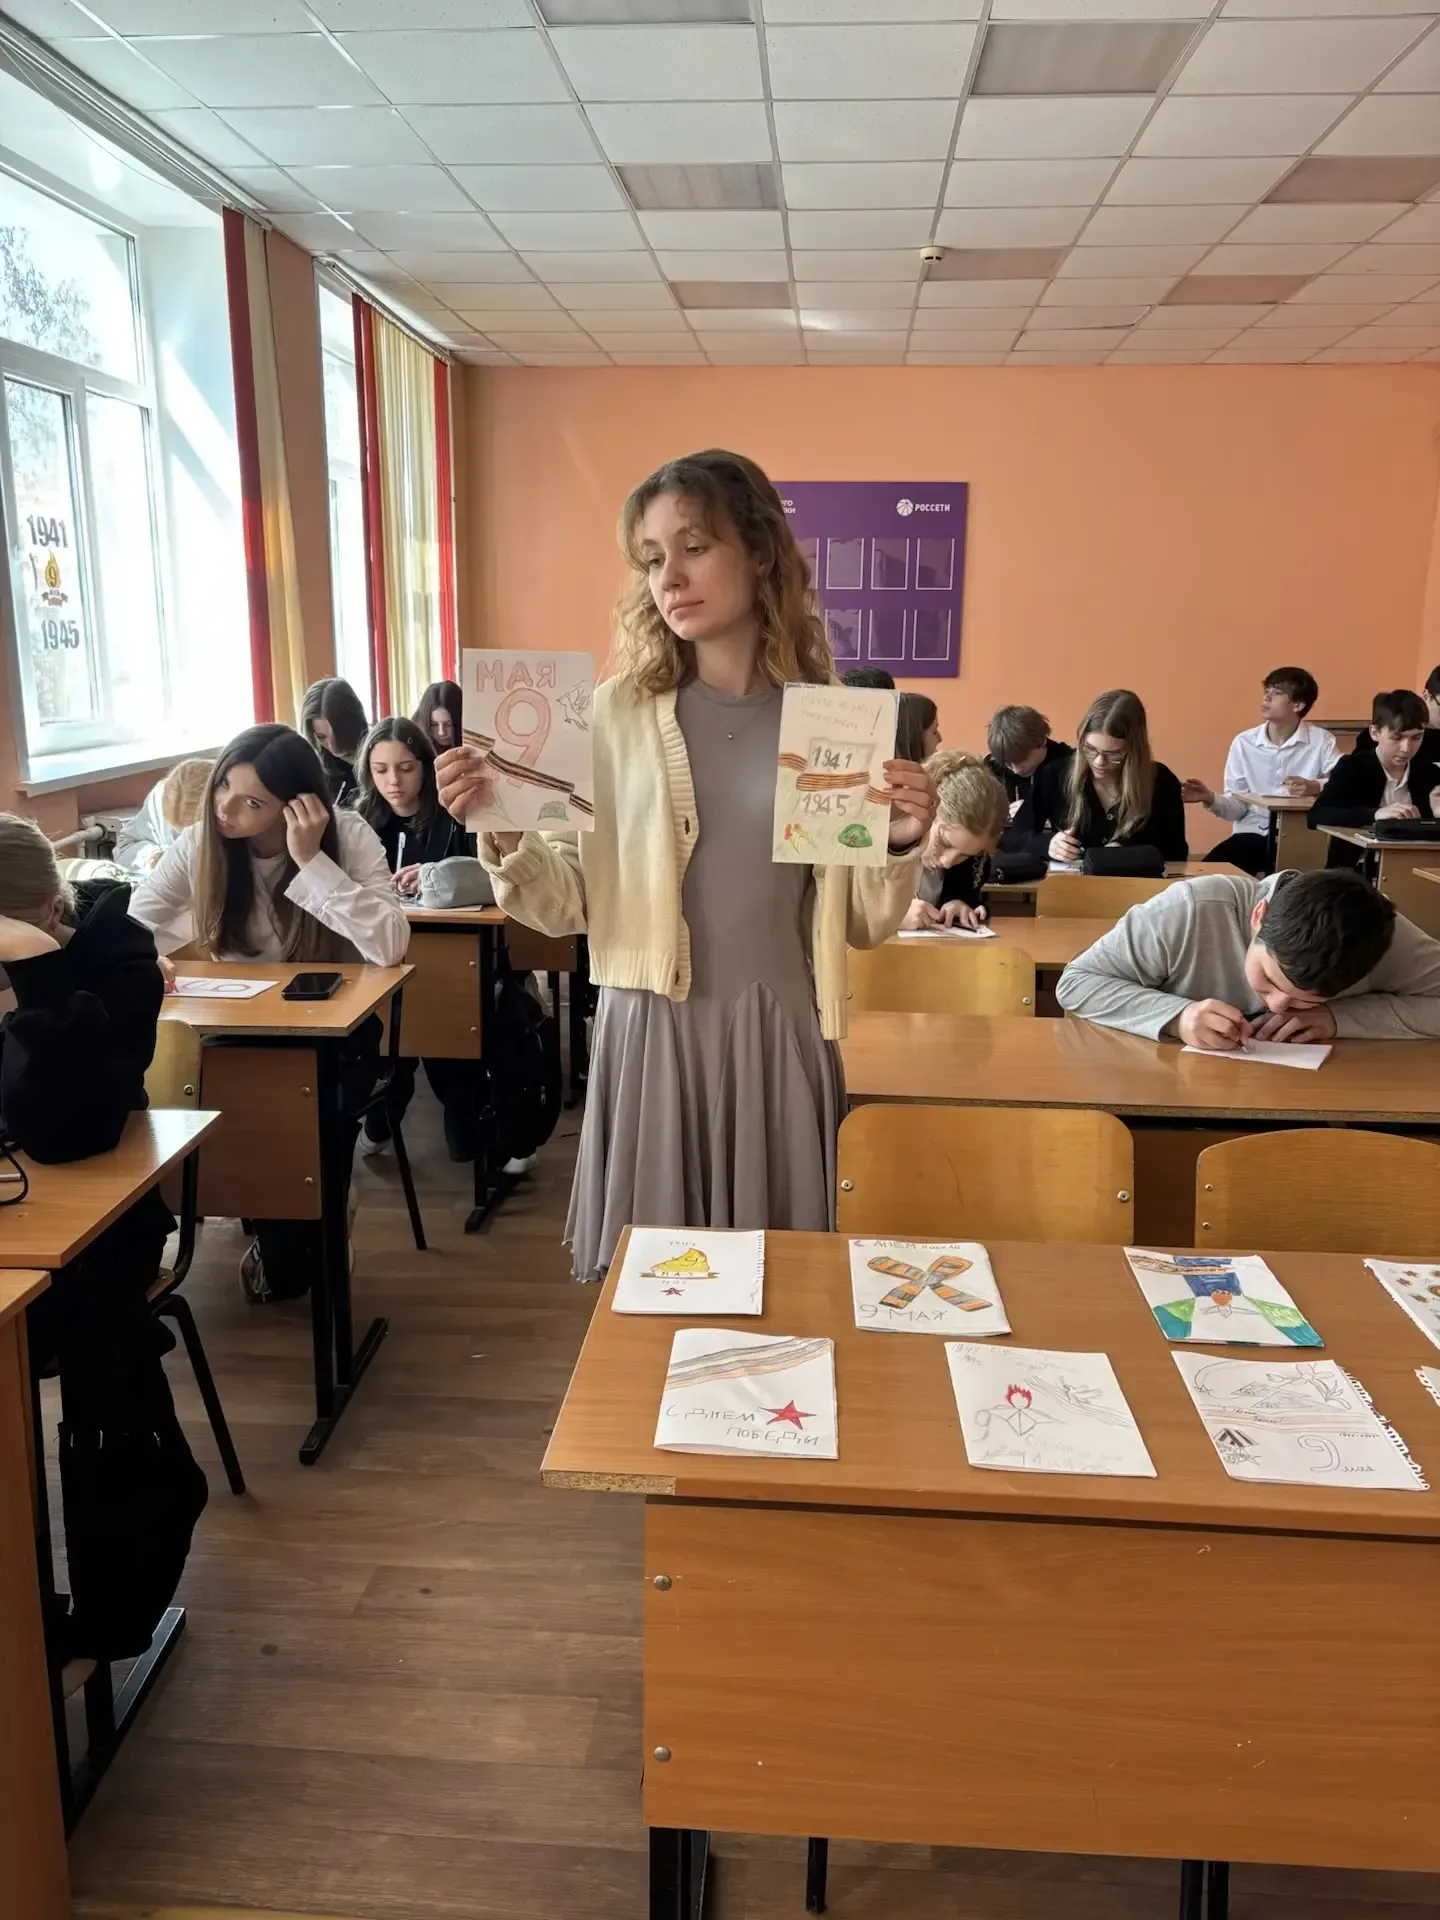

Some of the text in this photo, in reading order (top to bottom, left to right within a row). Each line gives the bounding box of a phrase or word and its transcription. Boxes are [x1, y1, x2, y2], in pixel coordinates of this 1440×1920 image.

[914, 503, 951, 512] РОССЕТИ
[27, 514, 68, 548] 1941
[49, 564, 57, 588] 9
[41, 619, 80, 650] 1945
[476, 659, 557, 692] МАЯ
[494, 687, 552, 789] 9
[811, 746, 853, 770] 1941
[802, 792, 852, 817] 1945
[859, 1304, 878, 1318] 9
[666, 1404, 679, 1417] С
[1296, 1434, 1341, 1473] 9
